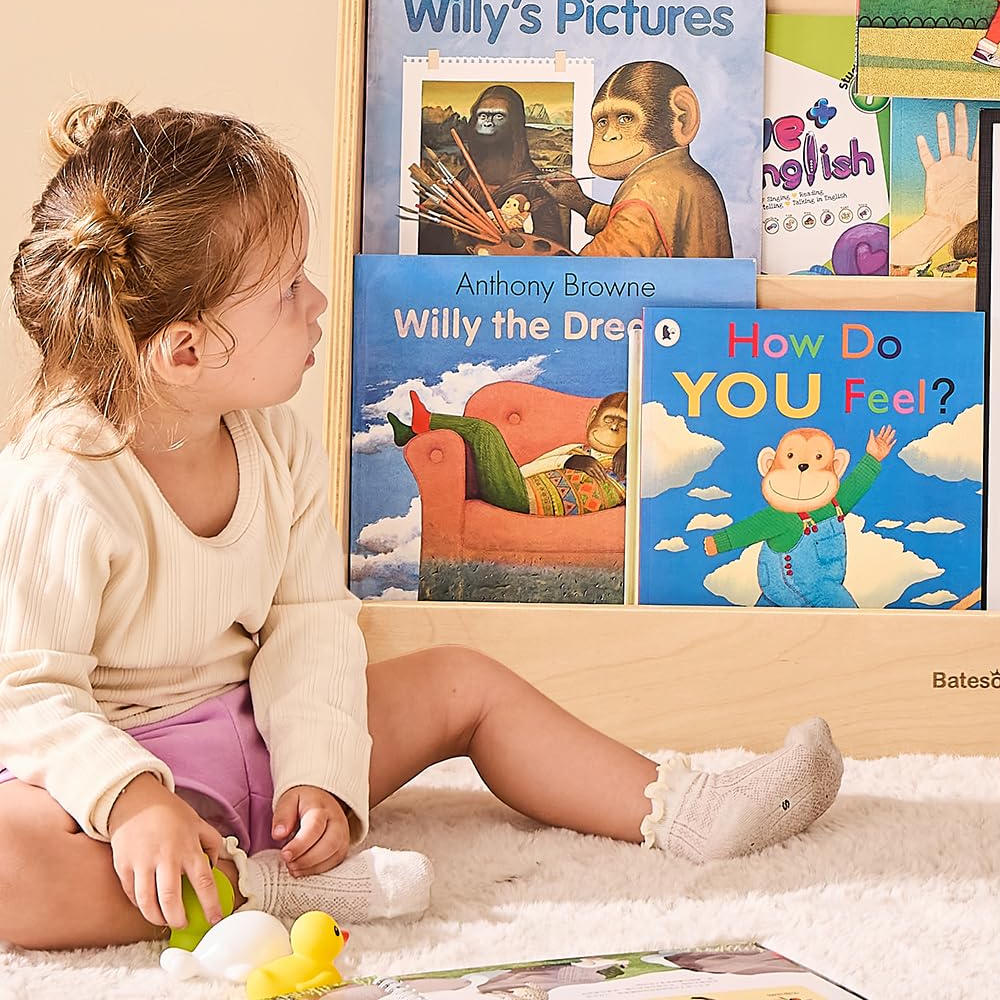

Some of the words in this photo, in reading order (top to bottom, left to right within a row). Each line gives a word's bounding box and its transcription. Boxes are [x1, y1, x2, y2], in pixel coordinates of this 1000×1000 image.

[763, 131, 875, 191] nglish
[455, 270, 555, 304] Anthony
[564, 272, 656, 298] Browne
[394, 307, 482, 347] Willy
[491, 308, 551, 340] the
[727, 321, 825, 359] How
[840, 322, 903, 360] Do
[671, 370, 822, 419] YOU
[844, 376, 956, 415] Feel?
